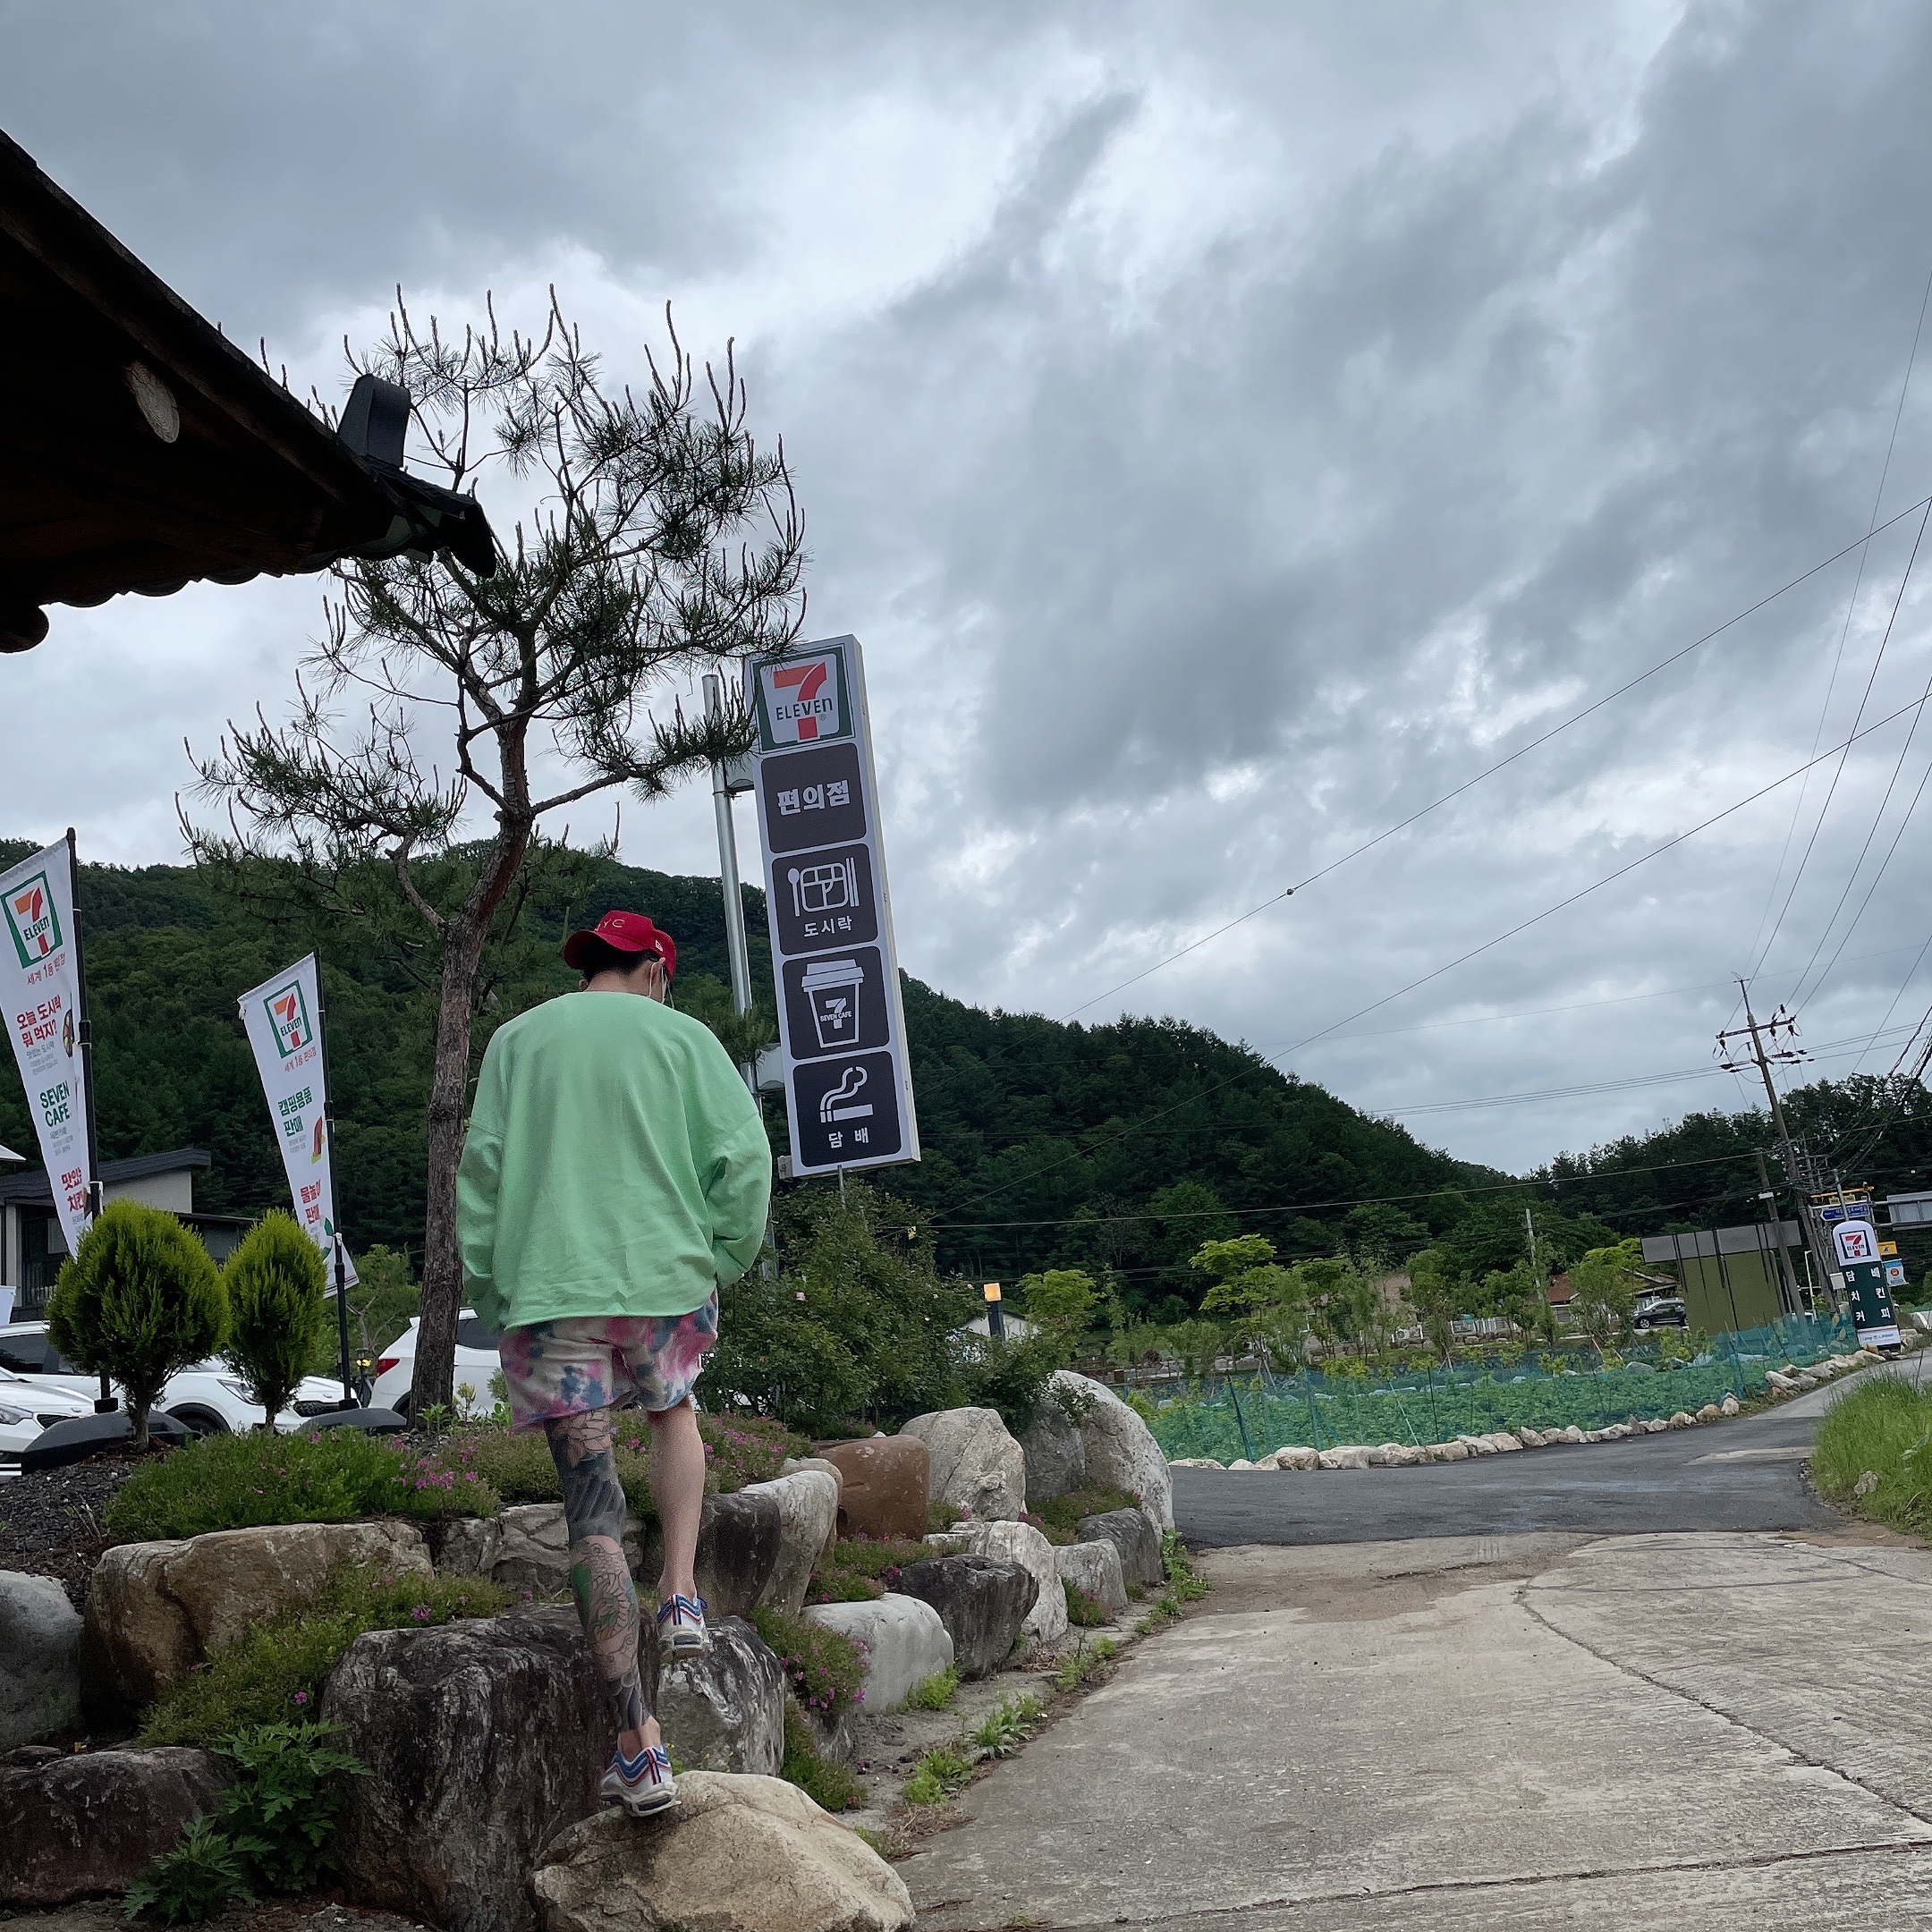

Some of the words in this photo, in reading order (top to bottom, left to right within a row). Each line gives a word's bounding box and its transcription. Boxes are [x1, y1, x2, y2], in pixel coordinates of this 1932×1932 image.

[773, 662, 826, 741] 7
[776, 779, 851, 816] 편의점
[803, 915, 852, 937] 도시락
[27, 970, 42, 985] 세계
[17, 1011, 37, 1030] 오늘
[37, 995, 62, 1021] 도시락
[819, 1013, 837, 1022] SEVEN
[837, 1011, 852, 1020] CAFE
[21, 1030, 34, 1047] 뭐
[34, 1019, 57, 1040] 먹지?
[39, 1080, 70, 1109] SEVEN
[277, 1087, 312, 1116] 캠핑용품
[45, 1102, 71, 1127] CAFE
[284, 1115, 303, 1137] 판매
[300, 1180, 321, 1204] 물놀이
[305, 1203, 320, 1224] 판매
